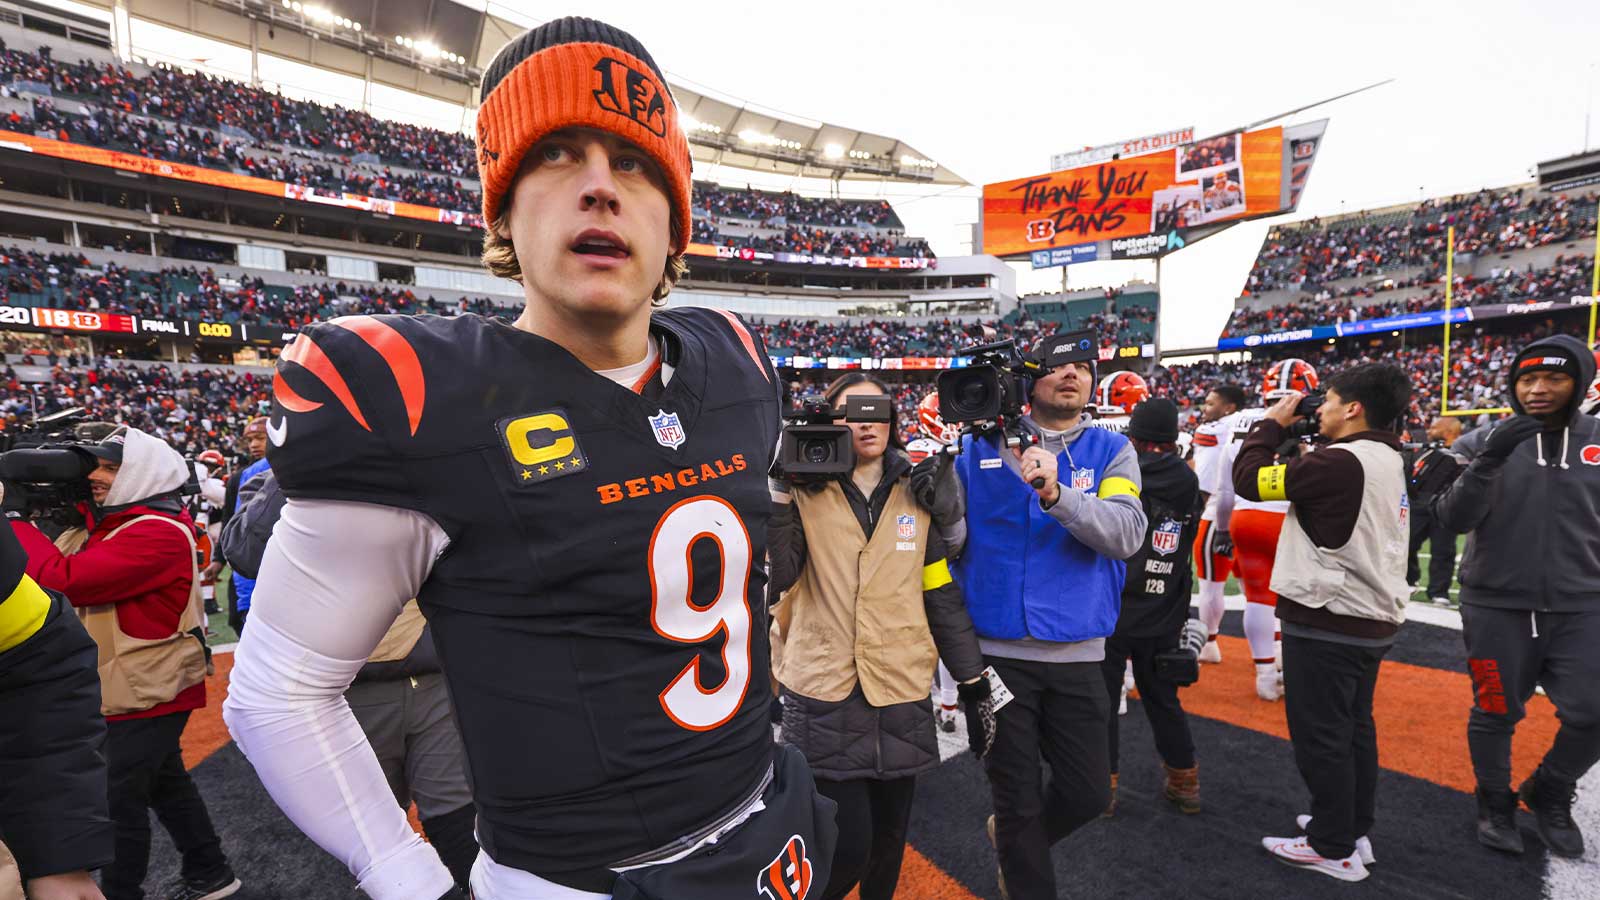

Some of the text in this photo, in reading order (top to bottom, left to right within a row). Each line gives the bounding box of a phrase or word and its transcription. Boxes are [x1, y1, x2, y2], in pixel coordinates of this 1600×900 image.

[1124, 128, 1193, 154] STADIUM
[1009, 176, 1091, 215] THANK
[1112, 234, 1167, 251] Kettering
[1126, 247, 1160, 256] HEALTH
[0, 305, 30, 325] 20
[41, 309, 70, 327] 18
[141, 319, 179, 333] FINAL
[199, 322, 232, 338] 0:00
[1263, 329, 1313, 345] HYUNDAI
[505, 412, 576, 466] C
[658, 426, 682, 443] NFL
[597, 453, 748, 505] BENGALS
[1152, 531, 1179, 550] NFL
[1144, 558, 1174, 575] MEDIA
[1144, 578, 1165, 594] 128
[647, 494, 753, 732] 9
